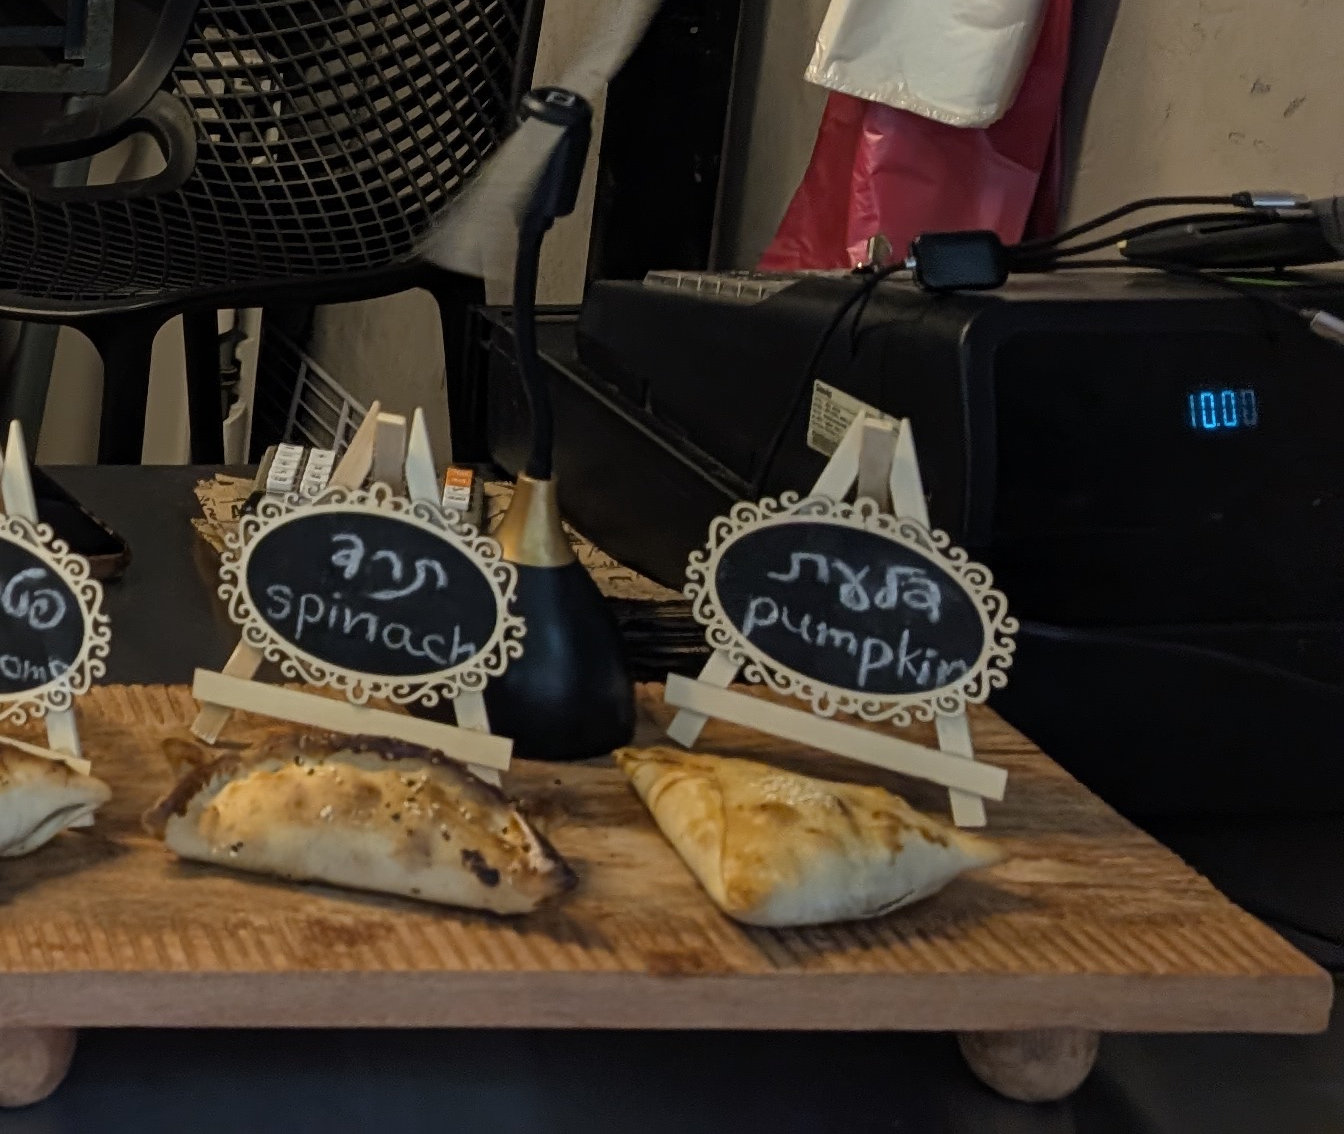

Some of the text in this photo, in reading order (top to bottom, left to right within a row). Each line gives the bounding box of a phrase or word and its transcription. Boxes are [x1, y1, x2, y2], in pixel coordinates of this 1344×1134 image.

[331, 533, 448, 600] תרד
[767, 552, 942, 624] דלעת
[266, 584, 476, 665] spinach
[743, 596, 968, 687] pumpkin
